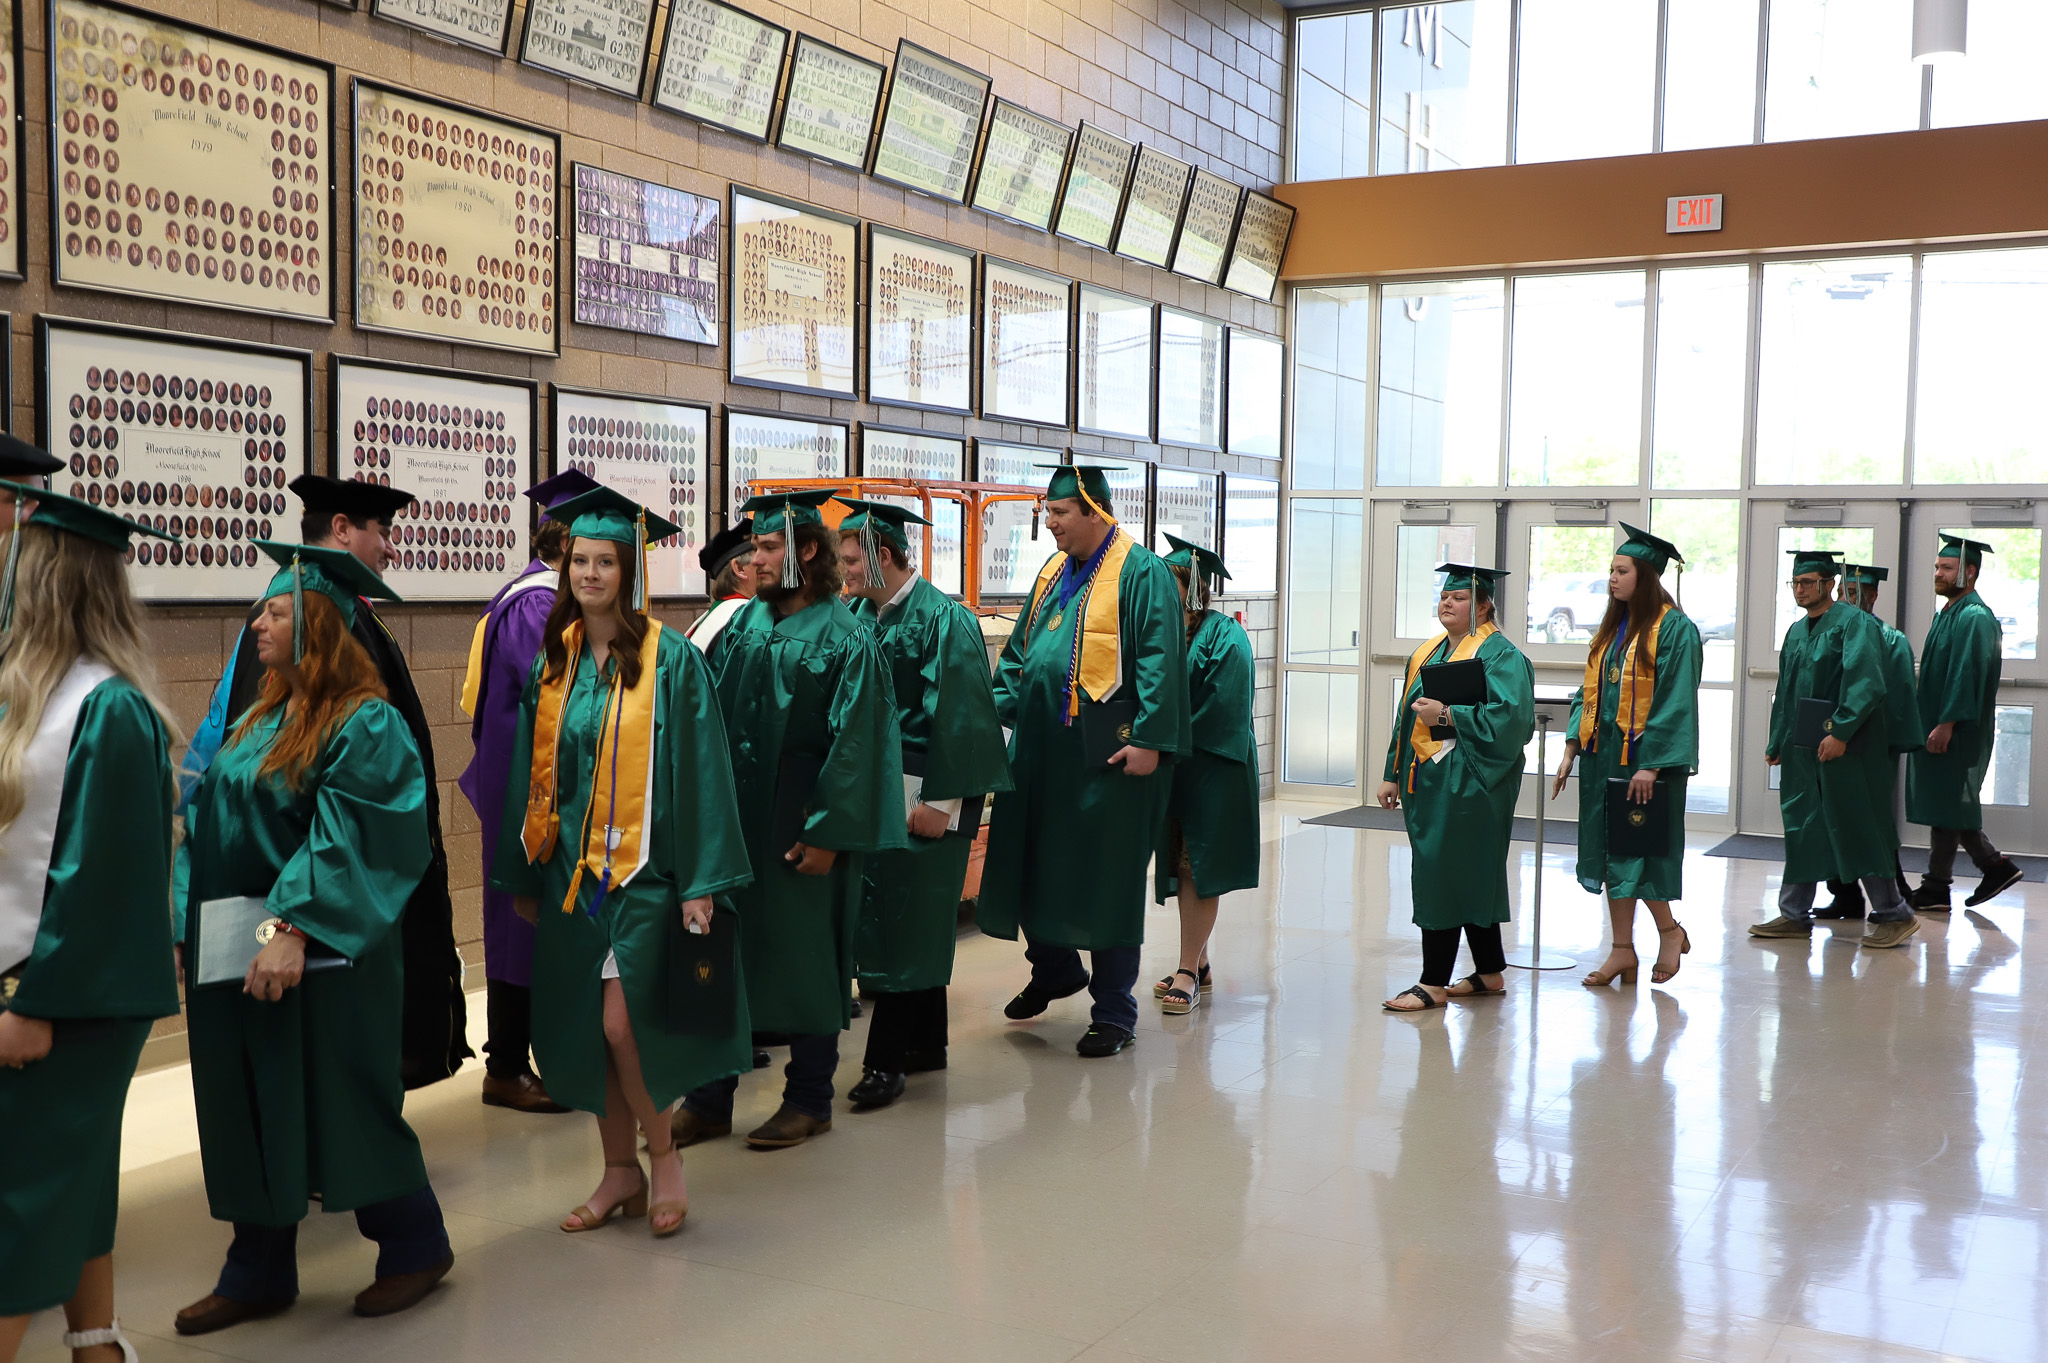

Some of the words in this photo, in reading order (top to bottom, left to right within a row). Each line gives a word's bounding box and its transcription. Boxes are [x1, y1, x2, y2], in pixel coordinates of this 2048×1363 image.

[553, 20, 567, 36] 19
[610, 40, 624, 56] 62
[804, 108, 813, 120] 19
[205, 112, 222, 129] High
[226, 121, 249, 142] School
[191, 138, 213, 153] 1979
[454, 201, 472, 213] 1980
[1677, 198, 1715, 227] EXIT
[145, 441, 184, 456] Moorefield
[184, 445, 201, 459] High
[200, 447, 222, 460] School
[406, 457, 438, 469] Moorefield
[438, 459, 452, 471] High
[451, 462, 470, 472] School
[433, 488, 447, 498] 1997
[699, 965, 710, 980] W
